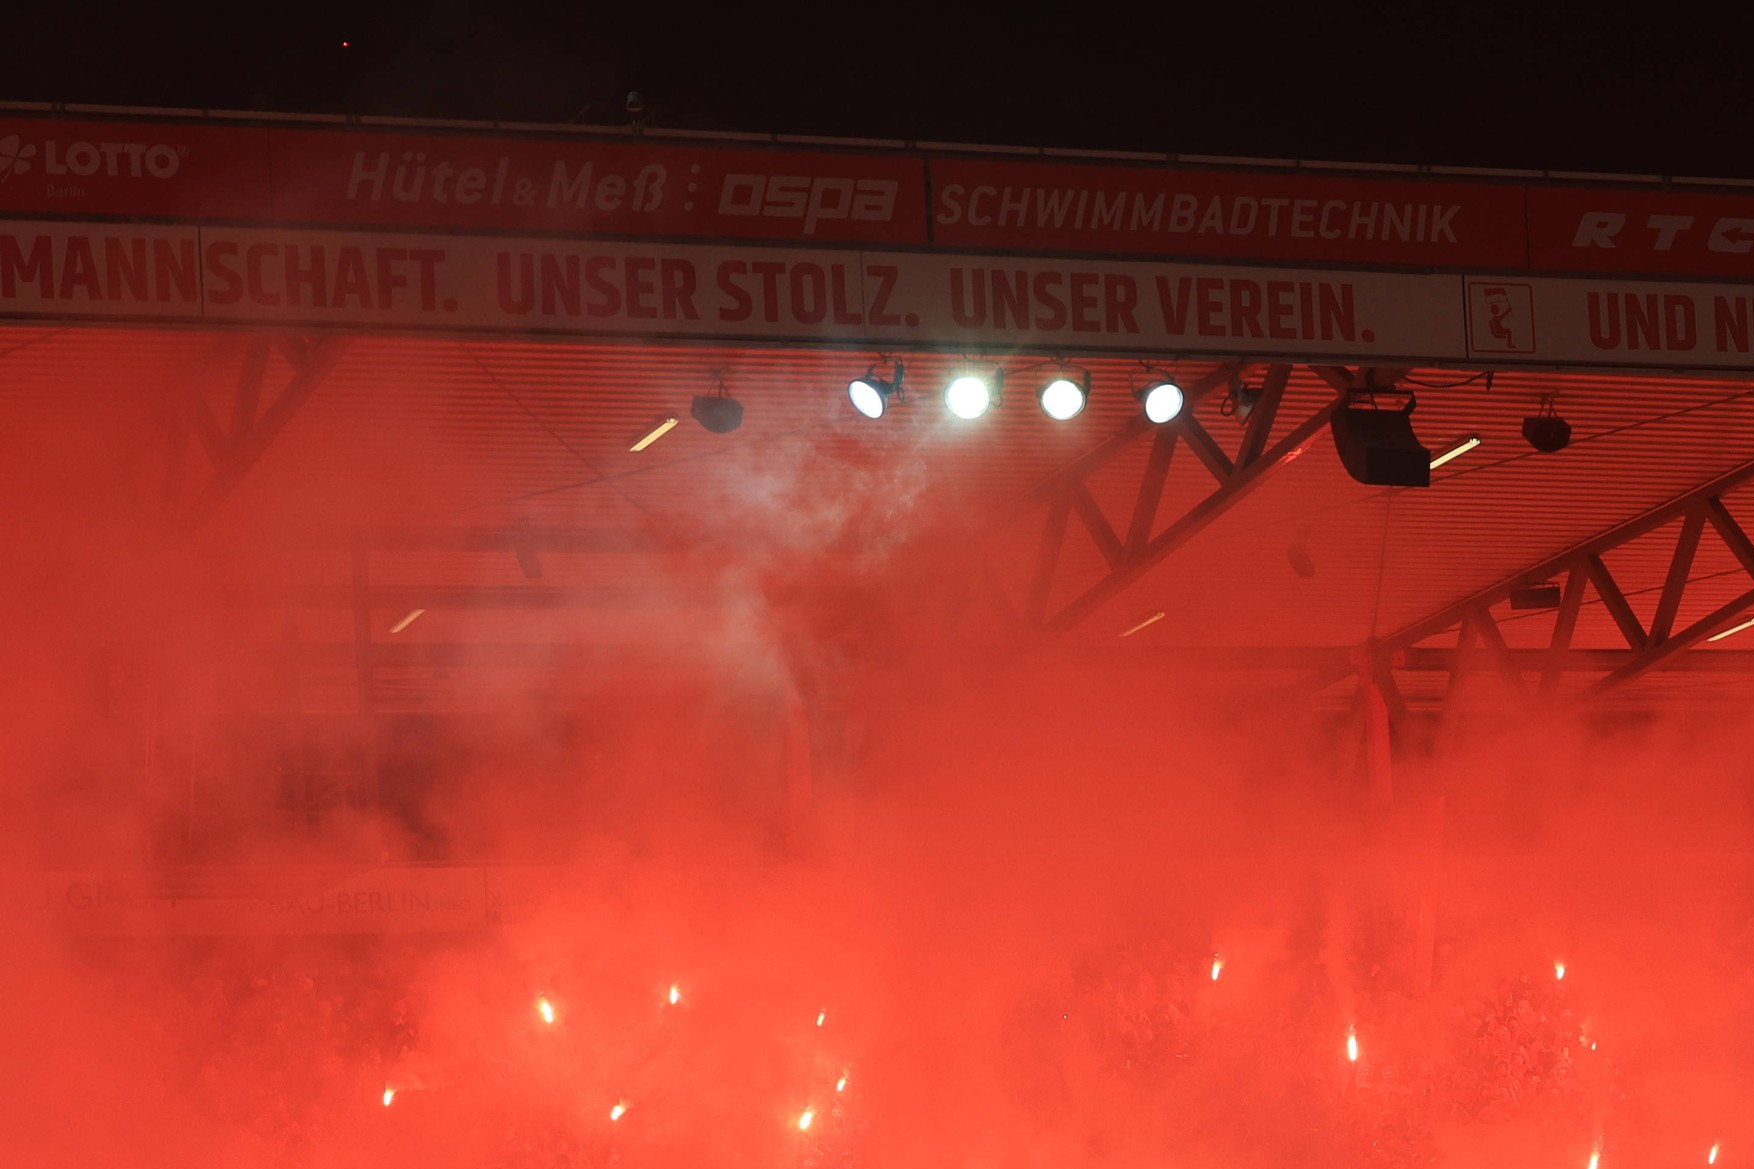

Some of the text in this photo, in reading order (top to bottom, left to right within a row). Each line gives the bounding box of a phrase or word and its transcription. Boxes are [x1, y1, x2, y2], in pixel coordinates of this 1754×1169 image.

[44, 140, 180, 179] LOTTO
[46, 184, 86, 200] Berlin
[718, 173, 898, 234] ospa
[937, 184, 1462, 244] SCHWIMMBADTECHNIK
[2, 235, 1376, 343] MANNSCHAFT. UNSER STOLZ. UNSER VEREIN.
[1588, 292, 1697, 352] UND
